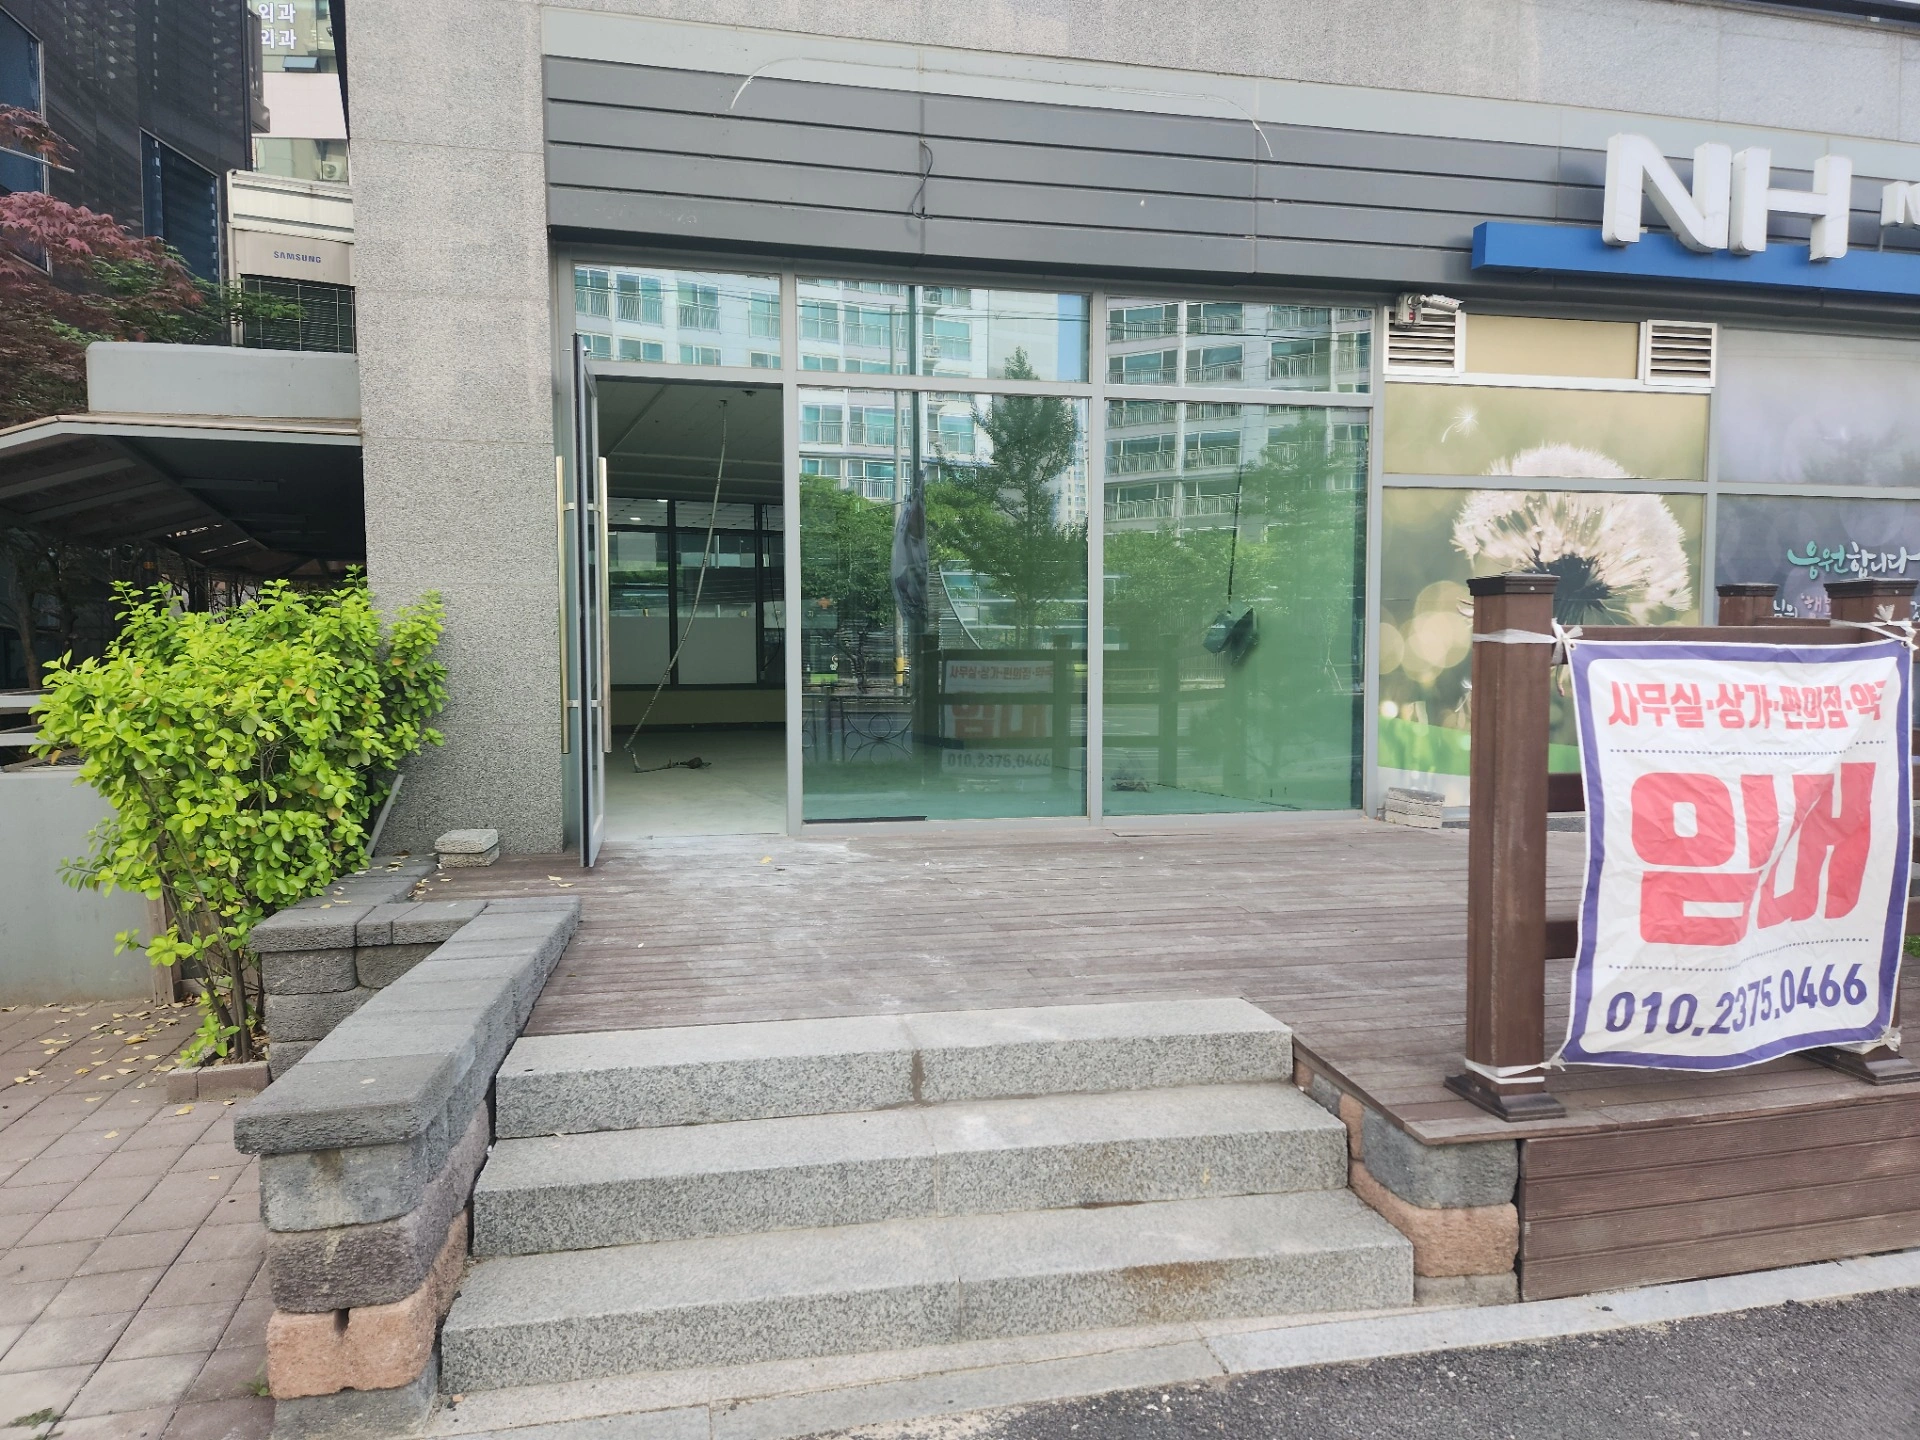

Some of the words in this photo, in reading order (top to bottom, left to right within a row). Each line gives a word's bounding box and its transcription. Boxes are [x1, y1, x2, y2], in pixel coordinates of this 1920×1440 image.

[257, 2, 296, 24] 외과
[261, 28, 297, 50] 외과
[1602, 132, 1853, 262] NH
[273, 250, 322, 264] SAMSUNG
[947, 753, 1051, 769] 010.2375.0466
[1630, 762, 1877, 947] 임대
[1604, 963, 1868, 1037] 010.2375.0466
